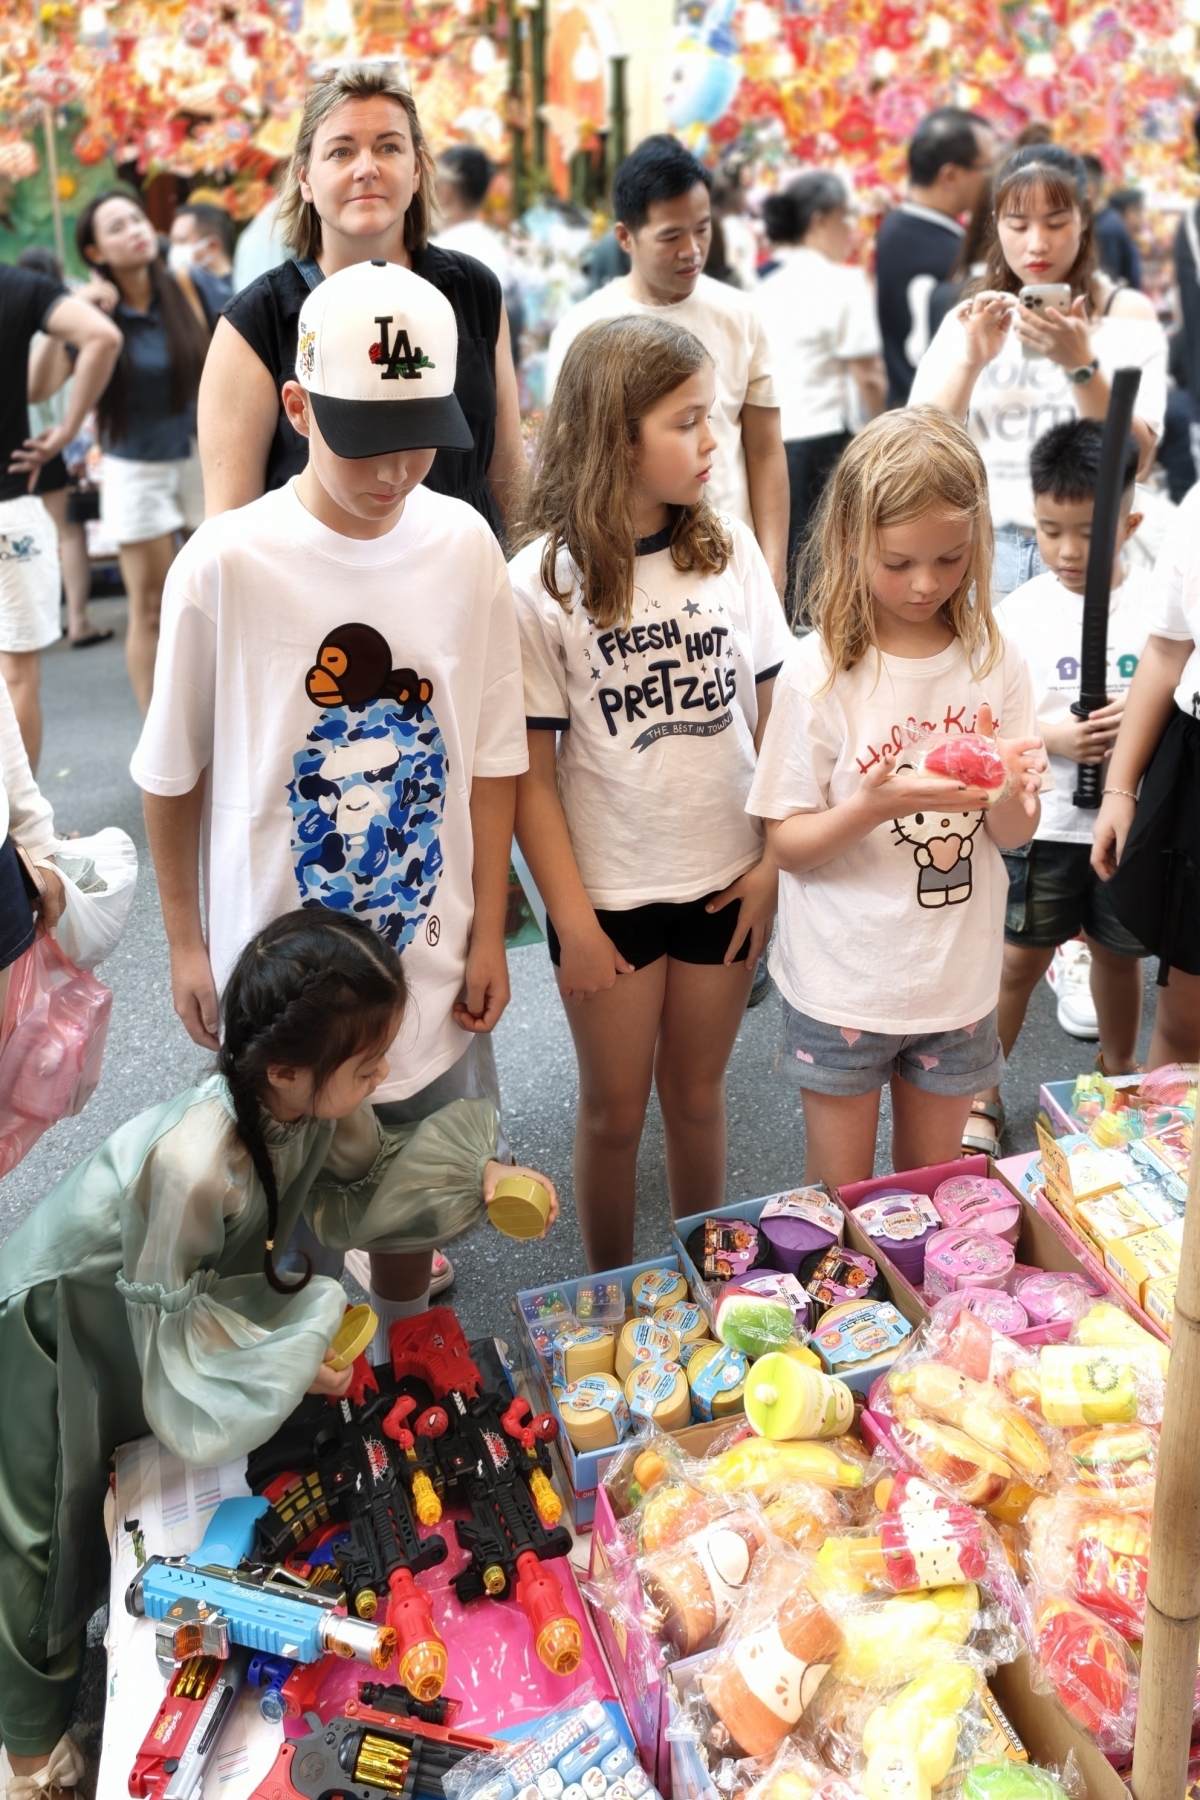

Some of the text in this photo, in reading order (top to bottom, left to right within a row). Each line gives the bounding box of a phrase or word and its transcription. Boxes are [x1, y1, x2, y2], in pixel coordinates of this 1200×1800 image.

[374, 316, 423, 380] LA
[597, 618, 729, 666] FRESH HOT
[646, 725, 670, 740] THE
[673, 723, 693, 734] BEST
[695, 724, 705, 734] IN
[227, 1584, 304, 1611] Special FORCE
